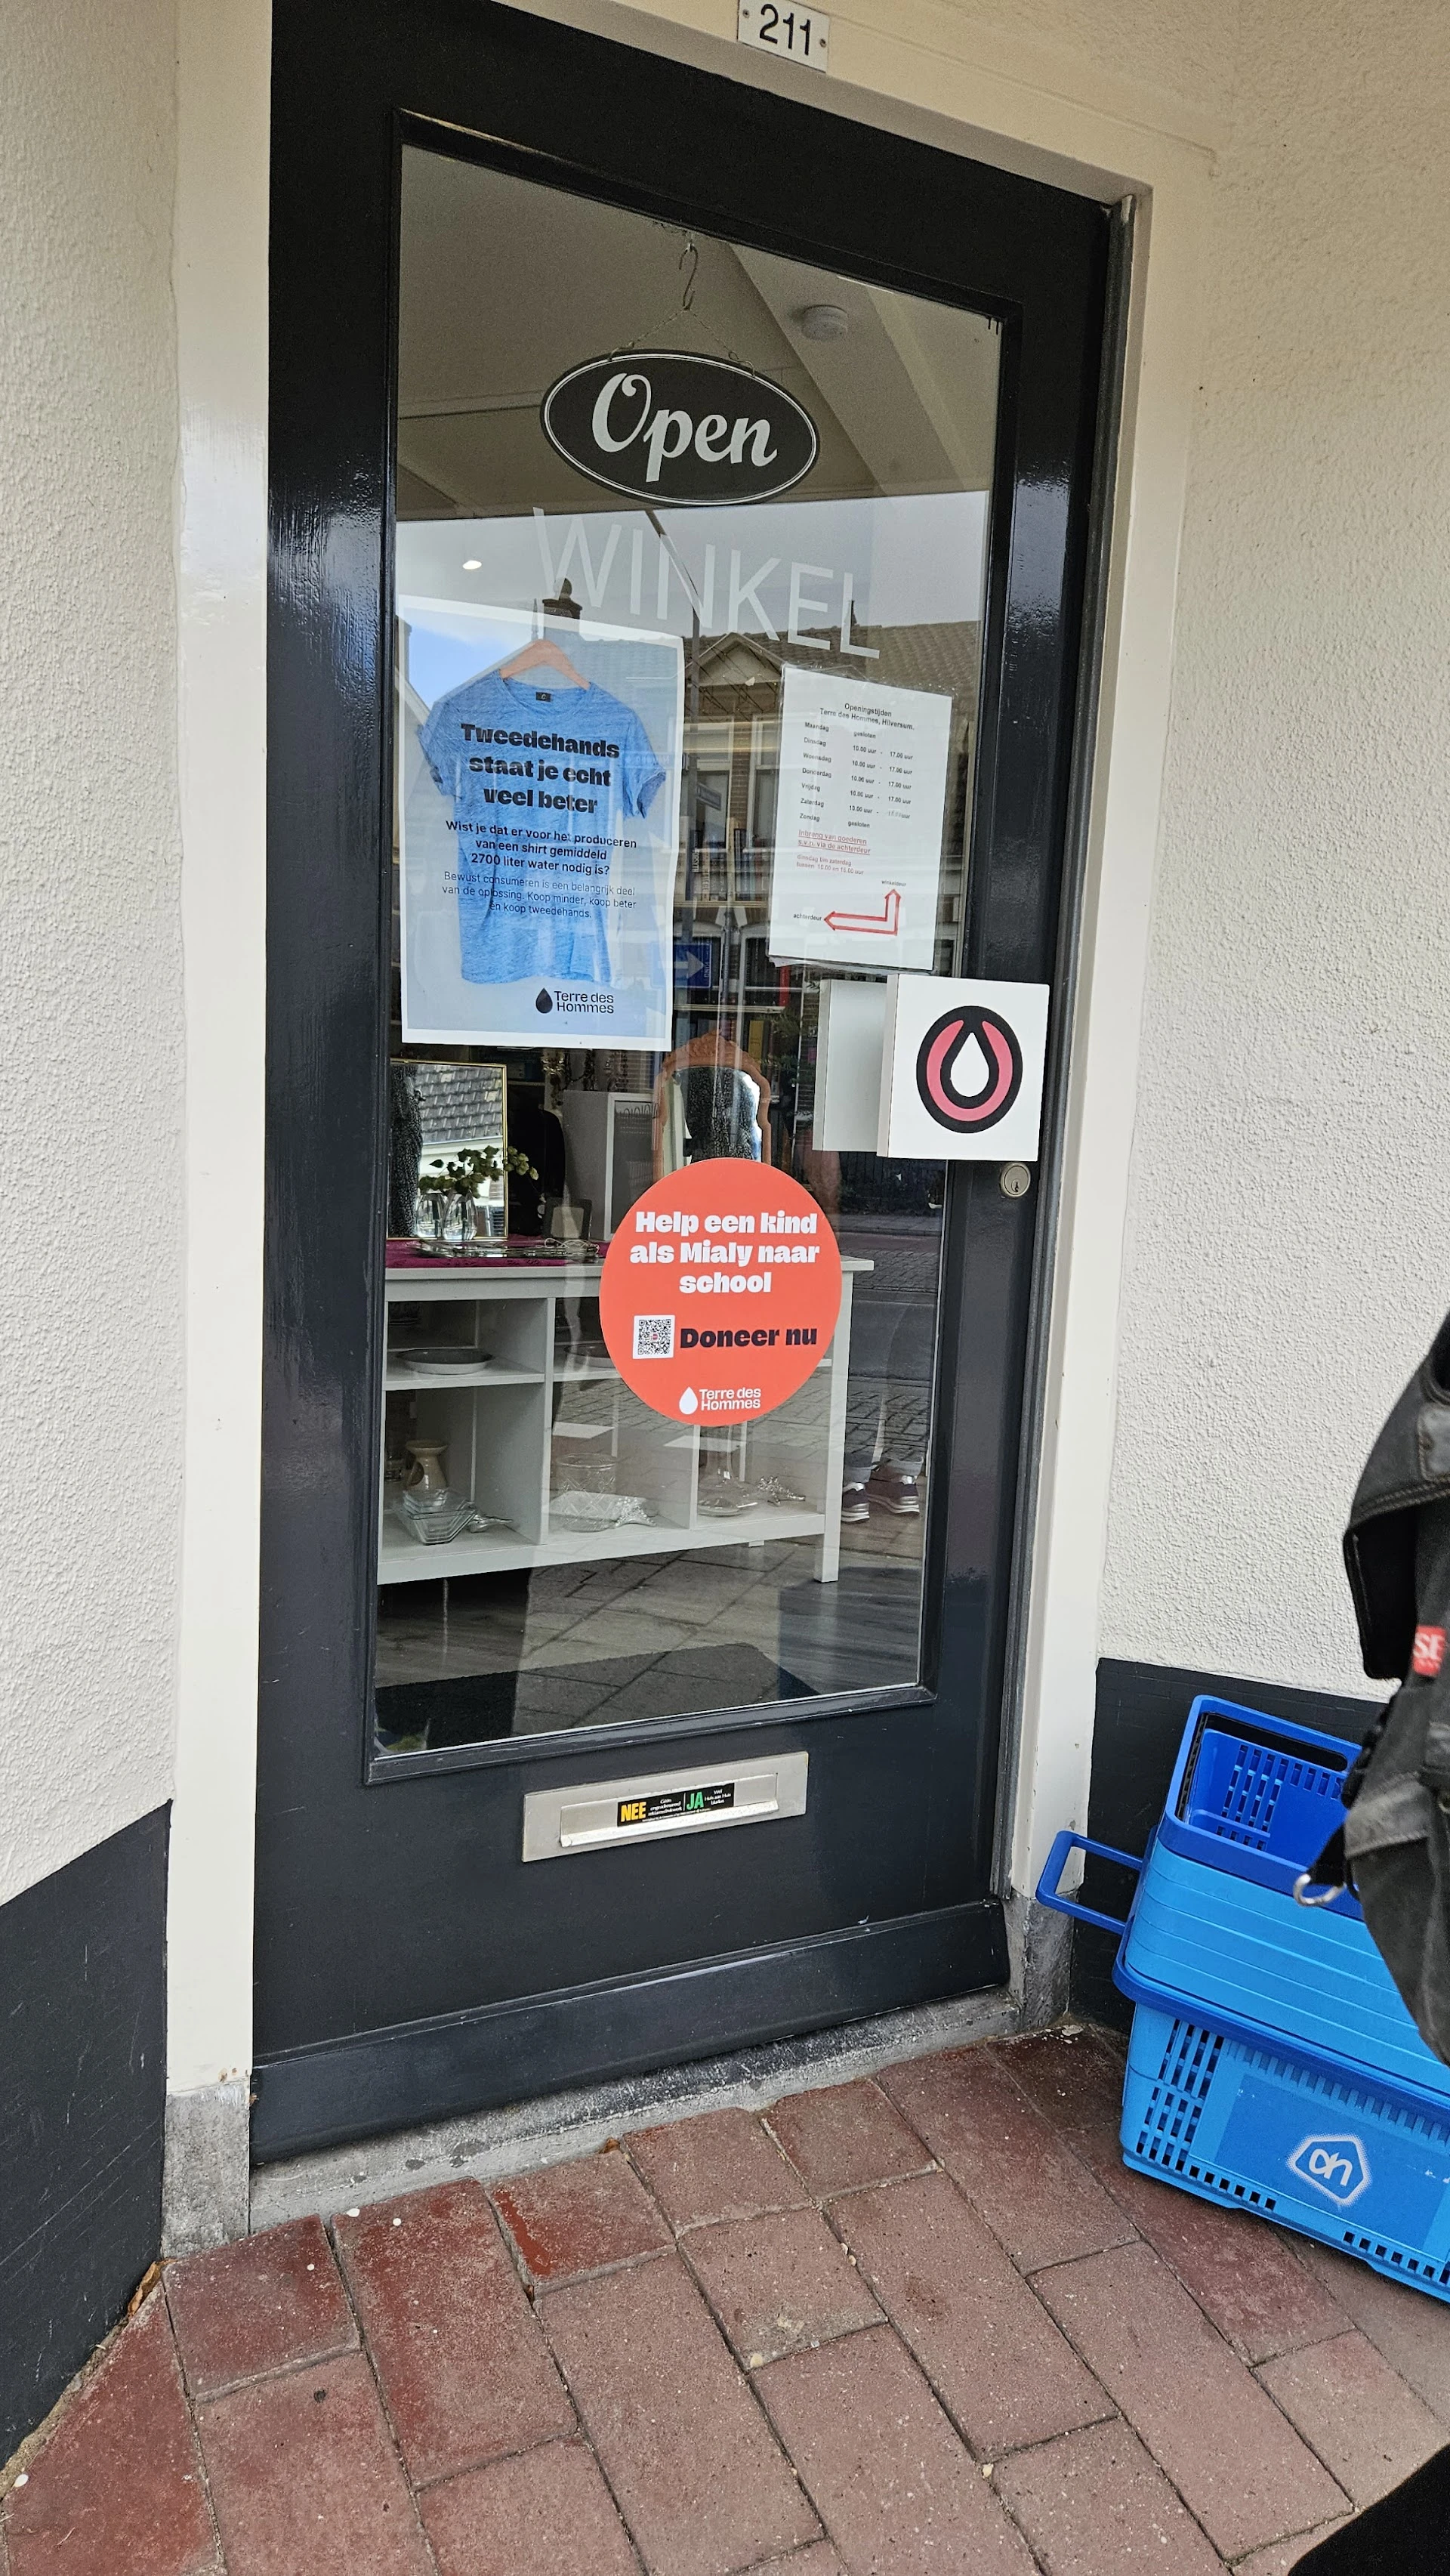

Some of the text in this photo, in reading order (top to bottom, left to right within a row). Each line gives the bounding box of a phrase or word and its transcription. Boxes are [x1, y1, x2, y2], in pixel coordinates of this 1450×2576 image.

[759, 4, 810, 55] 211
[592, 373, 777, 482] Open
[532, 507, 880, 659] WINKEL
[820, 708, 836, 716] Terre
[851, 714, 881, 724] Hommes,
[882, 719, 915, 730] Hilversum.
[844, 703, 892, 717] Openingstijden
[805, 722, 829, 731] Maandag
[461, 723, 619, 758] Tweedehands
[804, 737, 826, 746] Dinsdag
[804, 752, 831, 762] Woensdag
[469, 757, 611, 786] staat je echt
[802, 768, 831, 778] Donderdag
[802, 783, 820, 792] Vrijdag
[483, 788, 597, 813] veel beter
[801, 798, 824, 808] Zaterdag
[800, 813, 819, 822] Zondag
[446, 820, 637, 848] Wist je dat er voor het produceren
[838, 836, 866, 844] goederen
[476, 840, 607, 860] van een shirt gemiddeld
[798, 854, 818, 863] dinsdag
[838, 845, 870, 854] achterdeur
[471, 854, 609, 875] 2700 liter water nodig is?
[444, 872, 635, 896] Bewust consumeren is een belangrijk deel
[442, 886, 637, 909] van de oplossing. Koop minder, koop beter
[504, 903, 526, 914] koop
[529, 907, 591, 918] tweedehands.
[794, 913, 822, 921] achterdeur
[554, 991, 613, 1003] Terre des
[557, 1002, 614, 1014] Hommes
[636, 1210, 817, 1237] Help een kind
[630, 1239, 819, 1267] als Mialy naar
[680, 1271, 772, 1293] school
[680, 1328, 817, 1348] Doneer nu
[699, 1387, 761, 1400] Terre des
[701, 1399, 760, 1411] Hommes
[686, 1792, 704, 1810] JA
[621, 1802, 646, 1822] NEE
